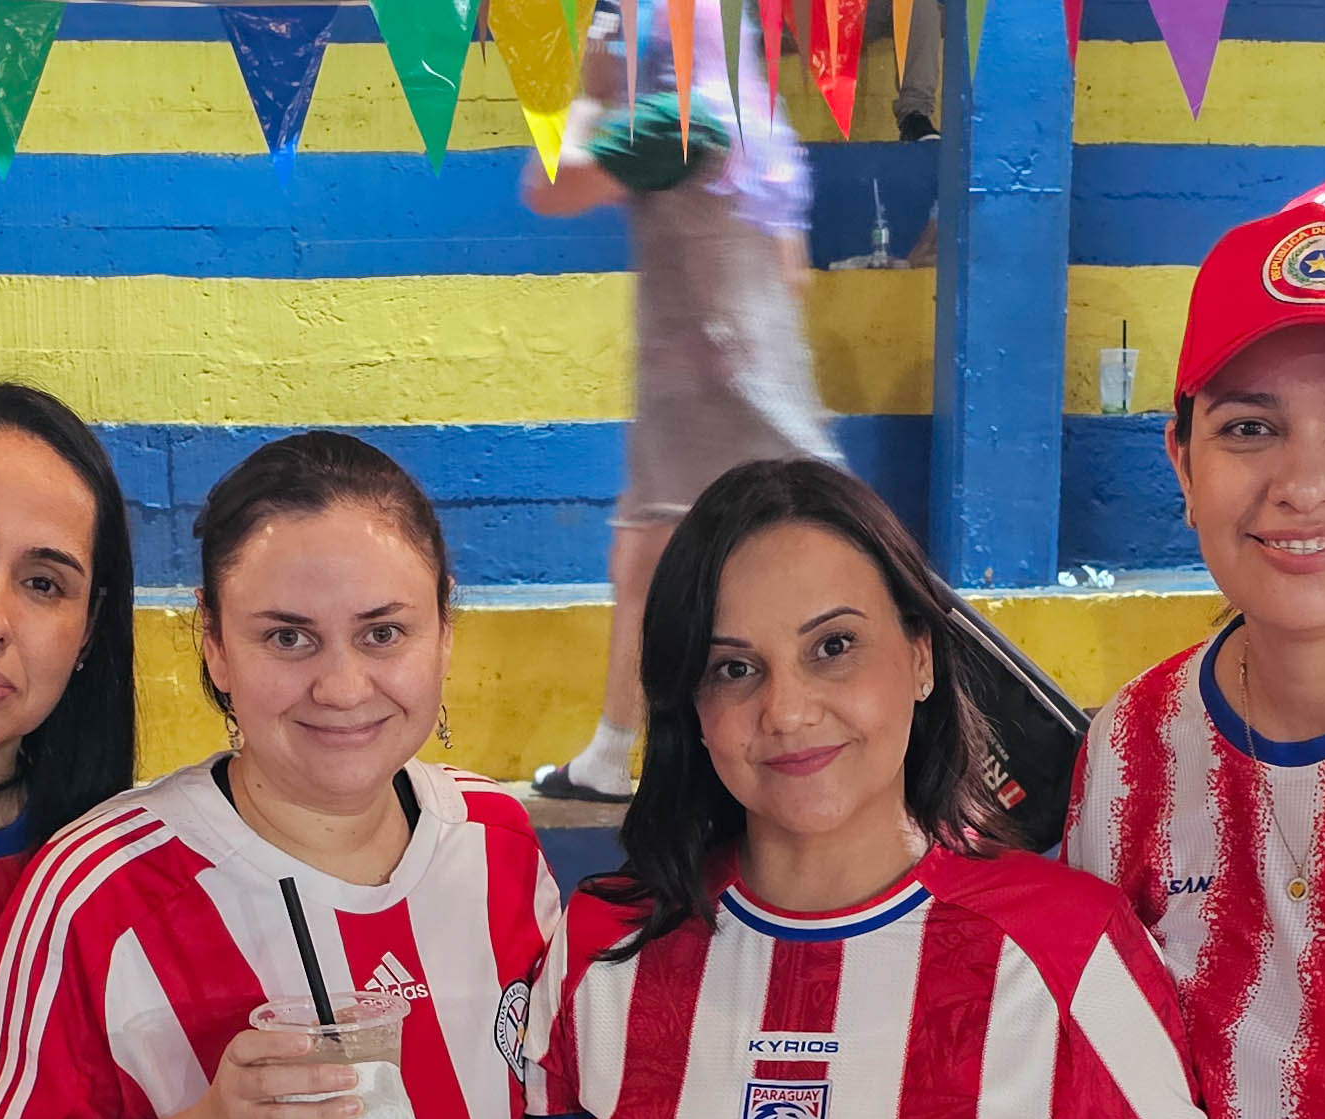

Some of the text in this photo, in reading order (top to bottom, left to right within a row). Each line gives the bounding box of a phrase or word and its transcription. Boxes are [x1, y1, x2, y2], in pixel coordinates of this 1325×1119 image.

[1271, 231, 1309, 282] REPUBLICA
[748, 1040, 840, 1053] KYRIOS
[752, 1088, 820, 1102] PARAGUAY
